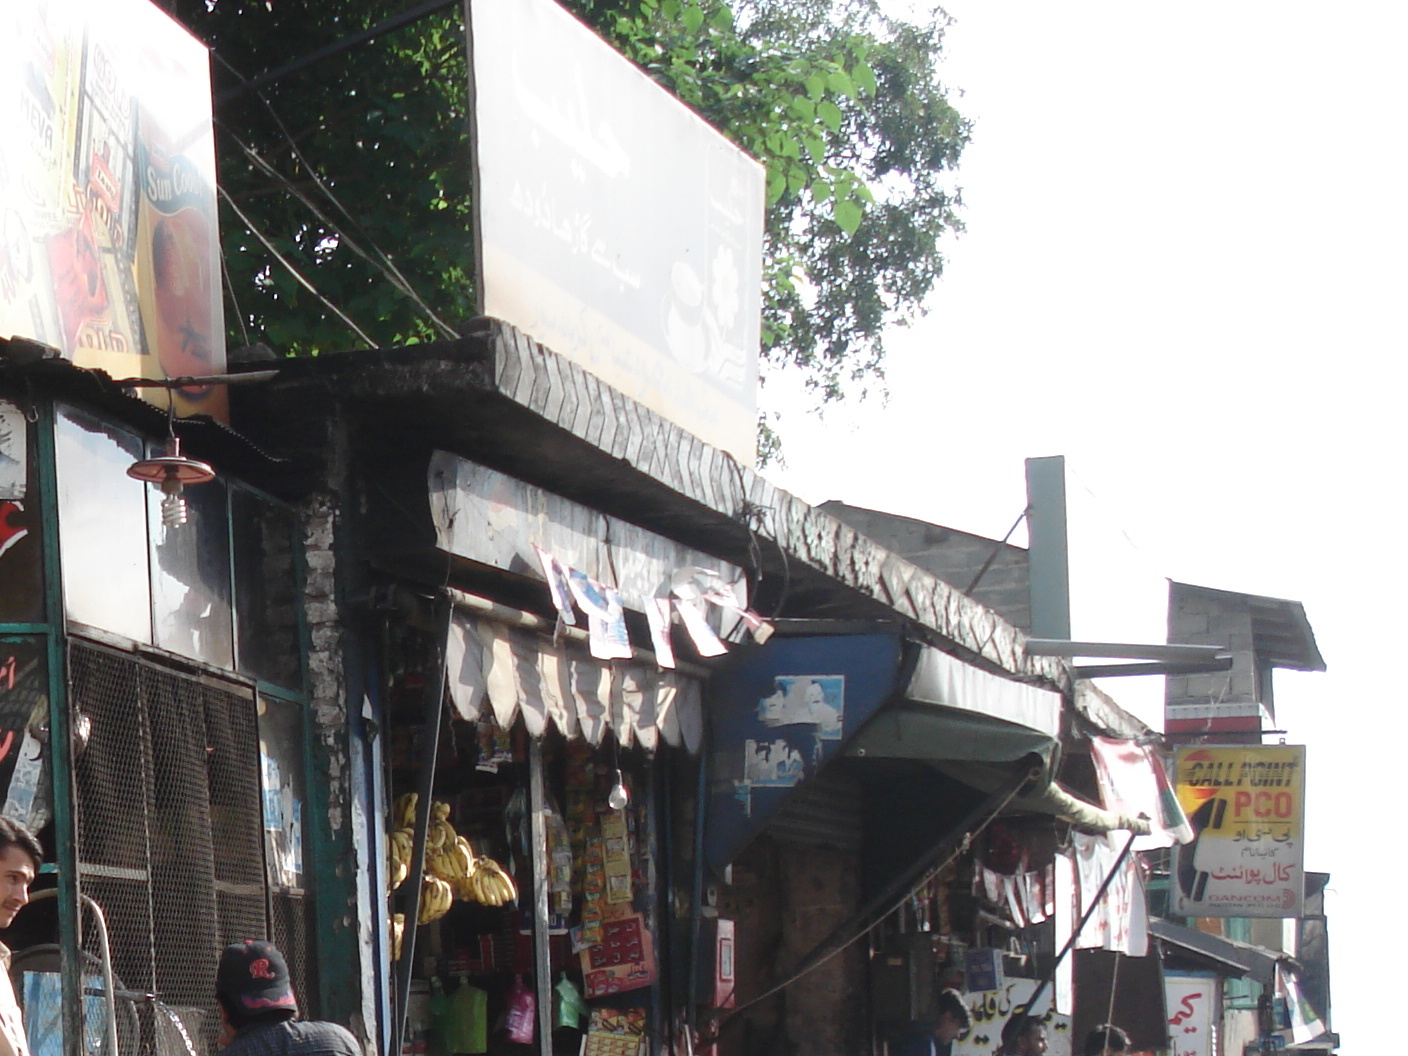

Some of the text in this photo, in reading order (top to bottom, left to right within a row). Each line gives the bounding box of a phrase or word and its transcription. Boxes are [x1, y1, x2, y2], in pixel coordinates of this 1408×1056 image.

[147, 166, 172, 202] Sun
[1186, 761, 1298, 787] CALL POINT
[1234, 791, 1293, 818] PCO
[1272, 828, 1293, 849] پی
[1210, 861, 1296, 886] کال پوائنٹ
[1208, 894, 1281, 903] DANCOM
[249, 958, 276, 980] R
[1167, 992, 1203, 1034] کیم
